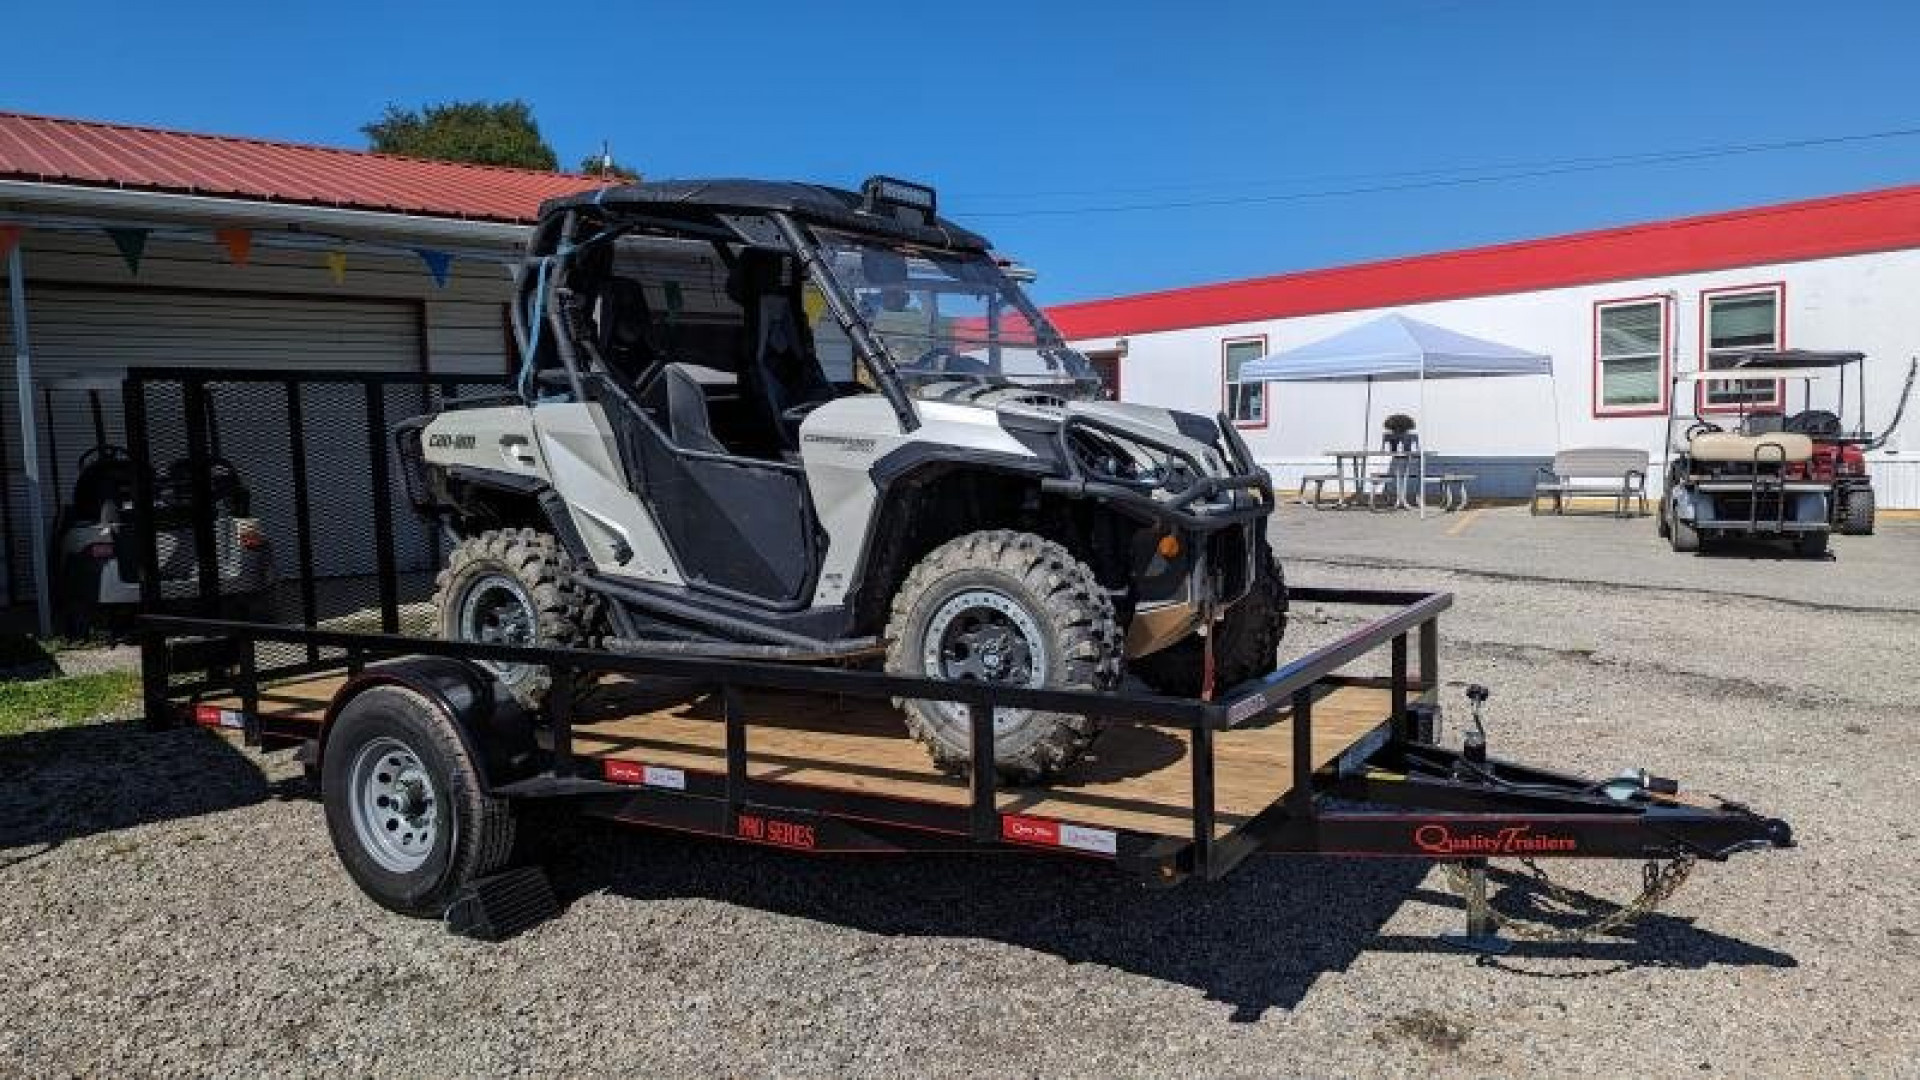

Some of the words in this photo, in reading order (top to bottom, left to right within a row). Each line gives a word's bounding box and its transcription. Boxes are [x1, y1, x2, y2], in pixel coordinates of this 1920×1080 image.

[767, 819, 815, 848] SERIES
[1415, 824, 1501, 853] Quality
[1497, 824, 1576, 852] Trailers
